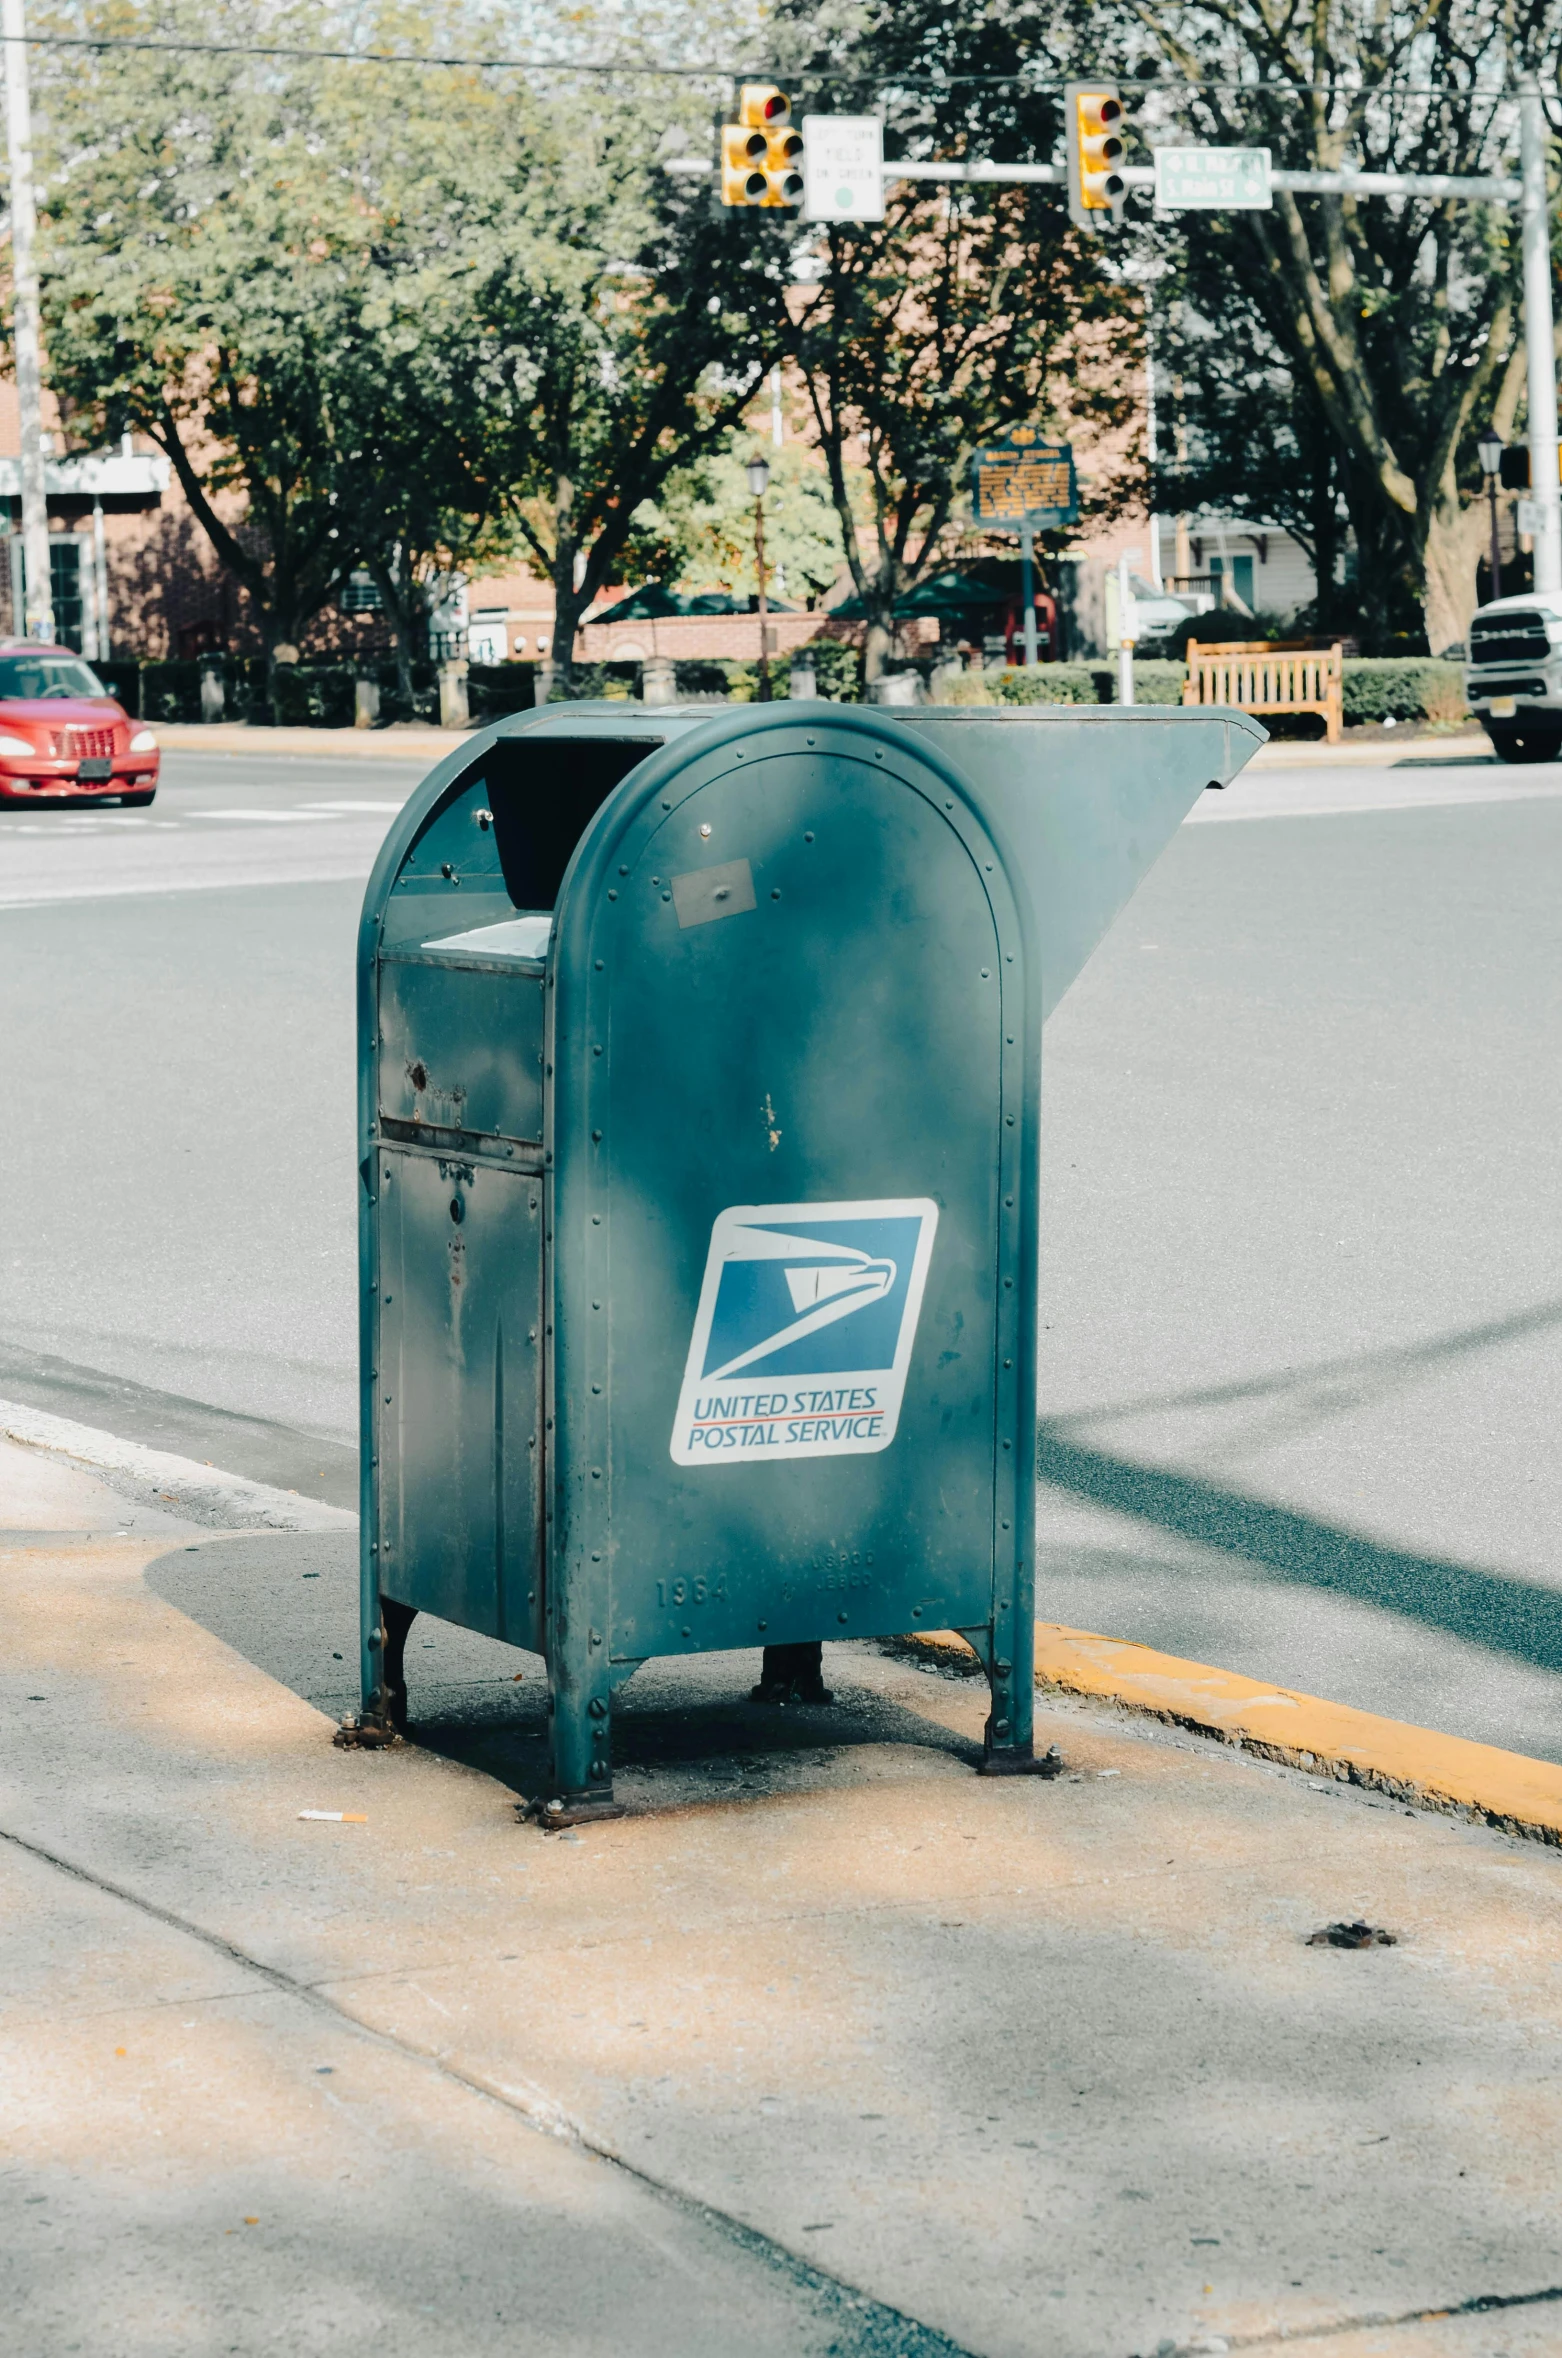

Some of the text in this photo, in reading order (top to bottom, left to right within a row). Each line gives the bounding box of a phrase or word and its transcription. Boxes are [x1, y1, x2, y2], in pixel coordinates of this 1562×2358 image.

[693, 1387, 877, 1420] UNITED STATES
[687, 1416, 883, 1450] POSTAL SERVICE
[656, 1573, 729, 1607] 1964
